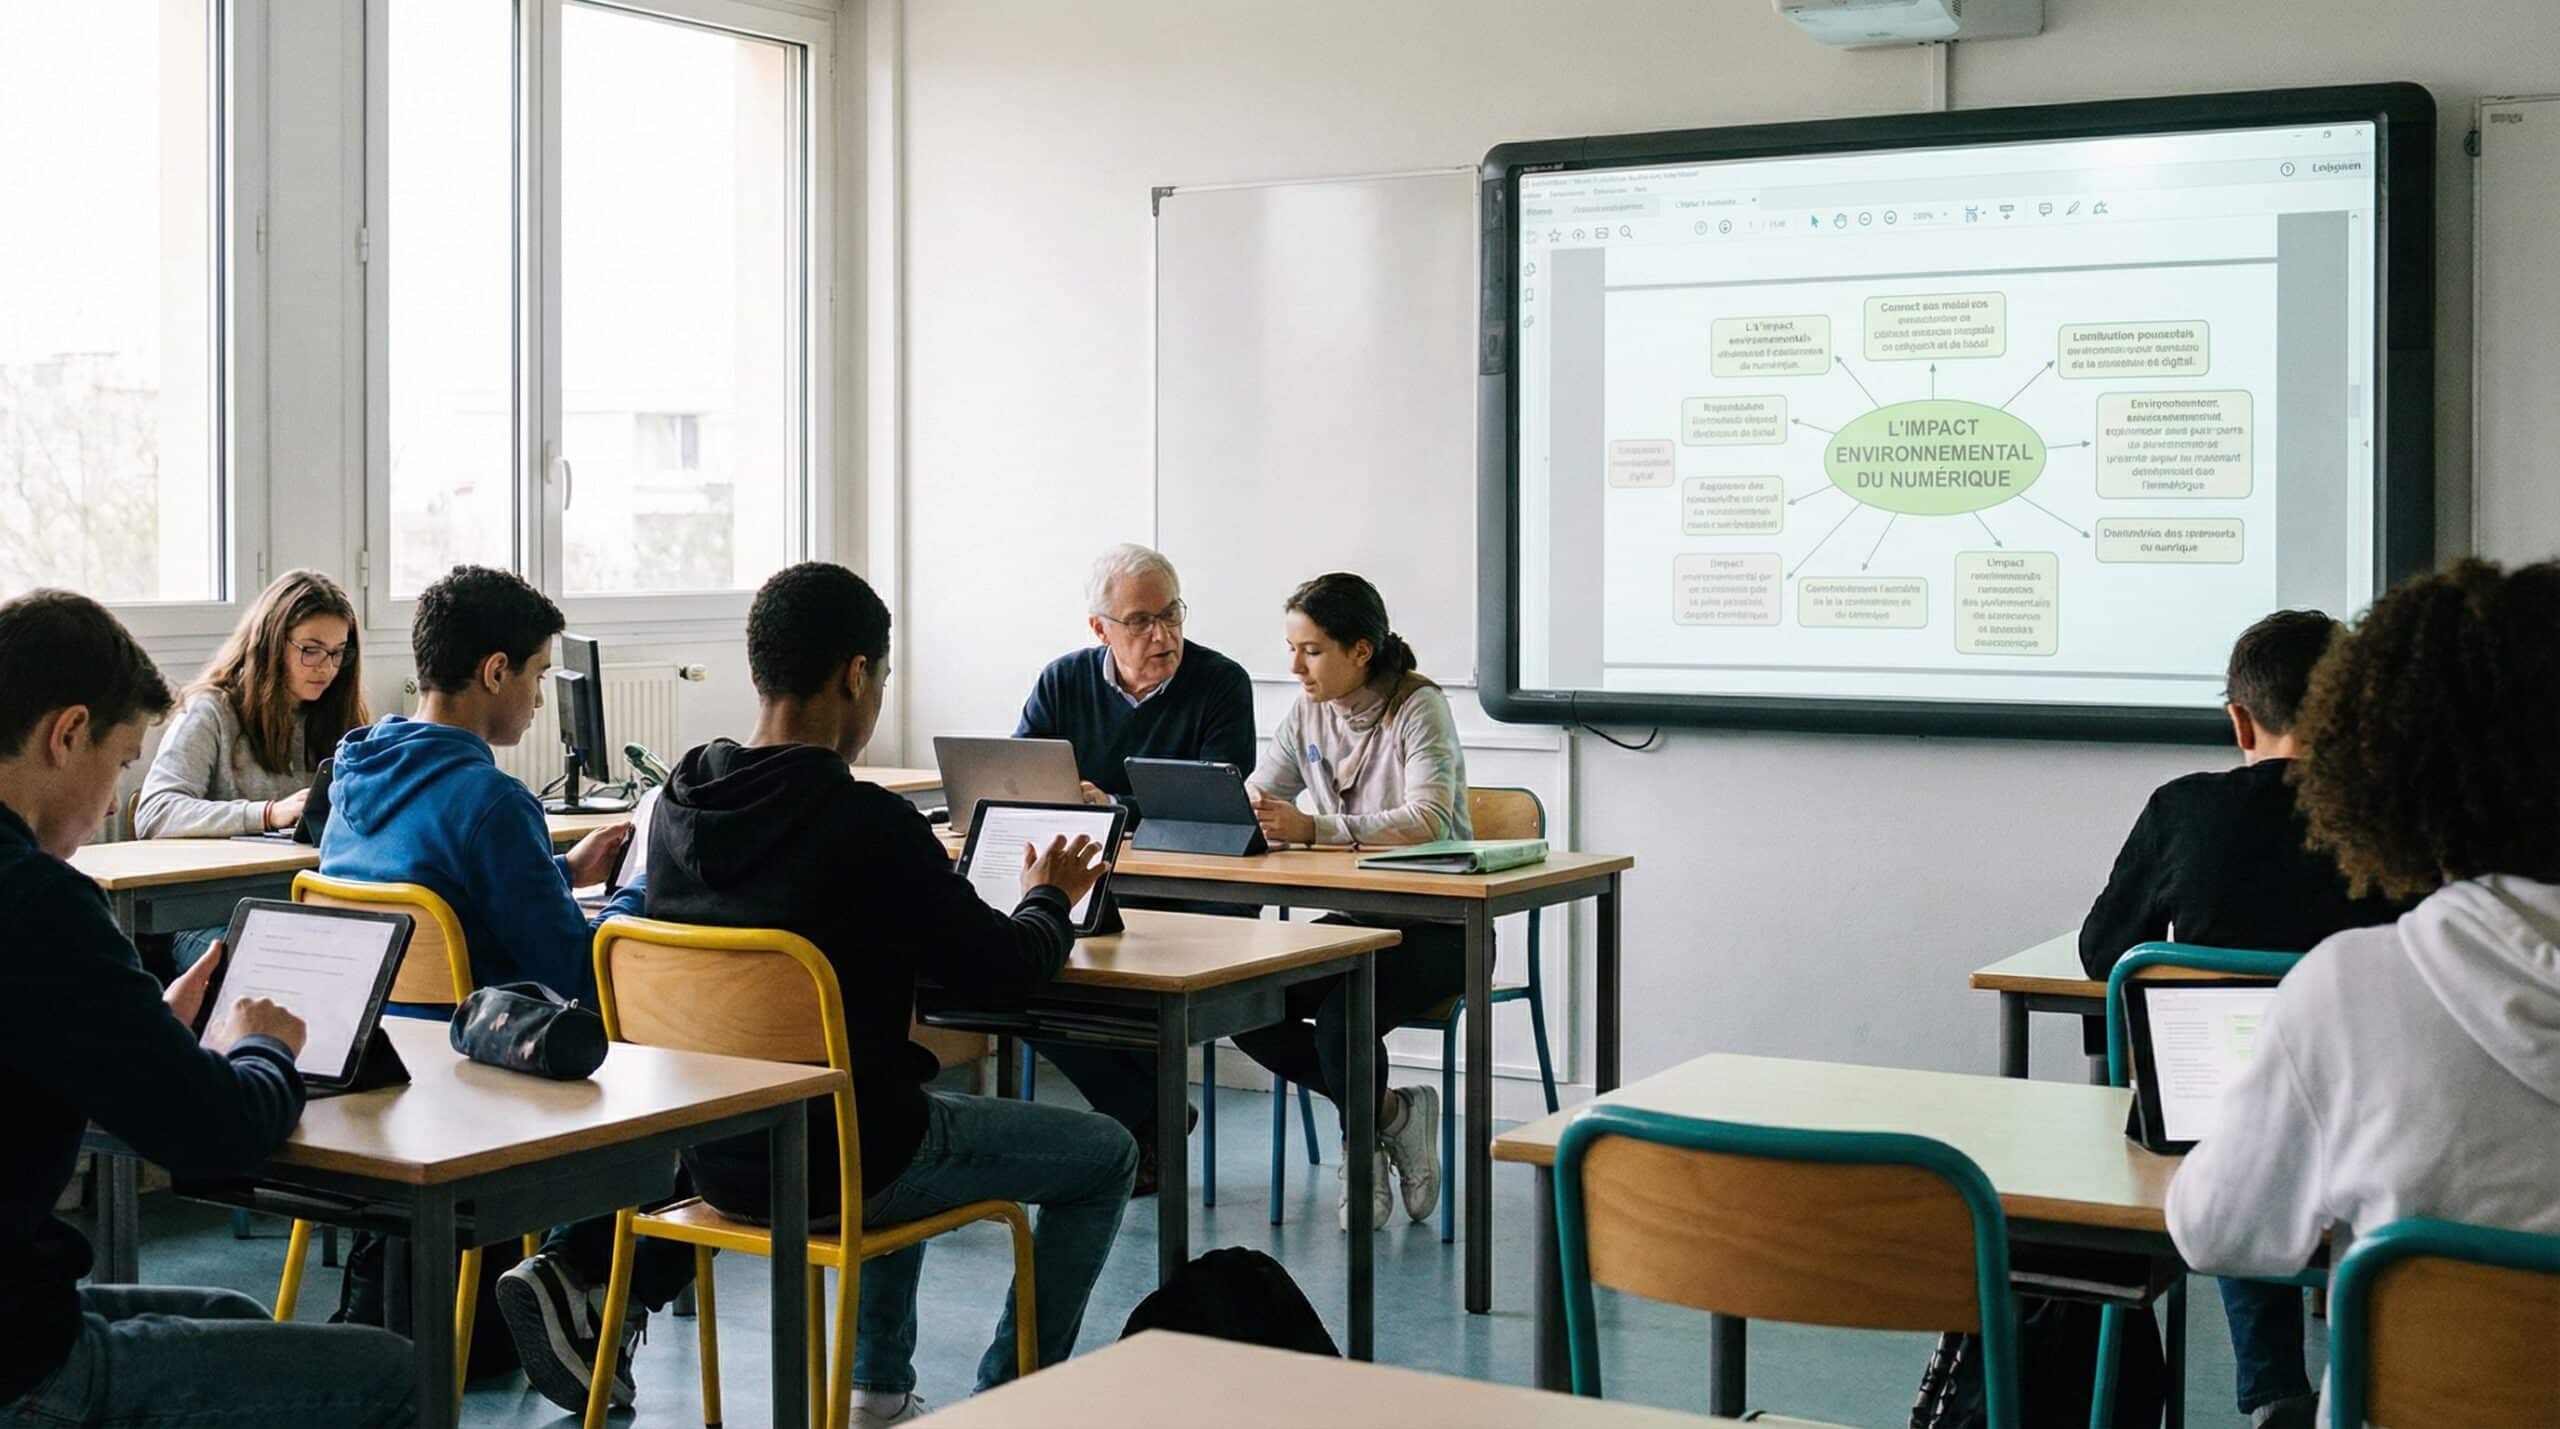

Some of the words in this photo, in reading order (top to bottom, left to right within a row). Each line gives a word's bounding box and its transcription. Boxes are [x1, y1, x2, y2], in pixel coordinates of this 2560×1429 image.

[1888, 419, 1980, 437] L'IMPACT
[1836, 443, 2034, 464] ENVIRONNEMENTAL
[1857, 471, 1884, 489] DU
[1890, 466, 2011, 488] NUMÉRIQUE
